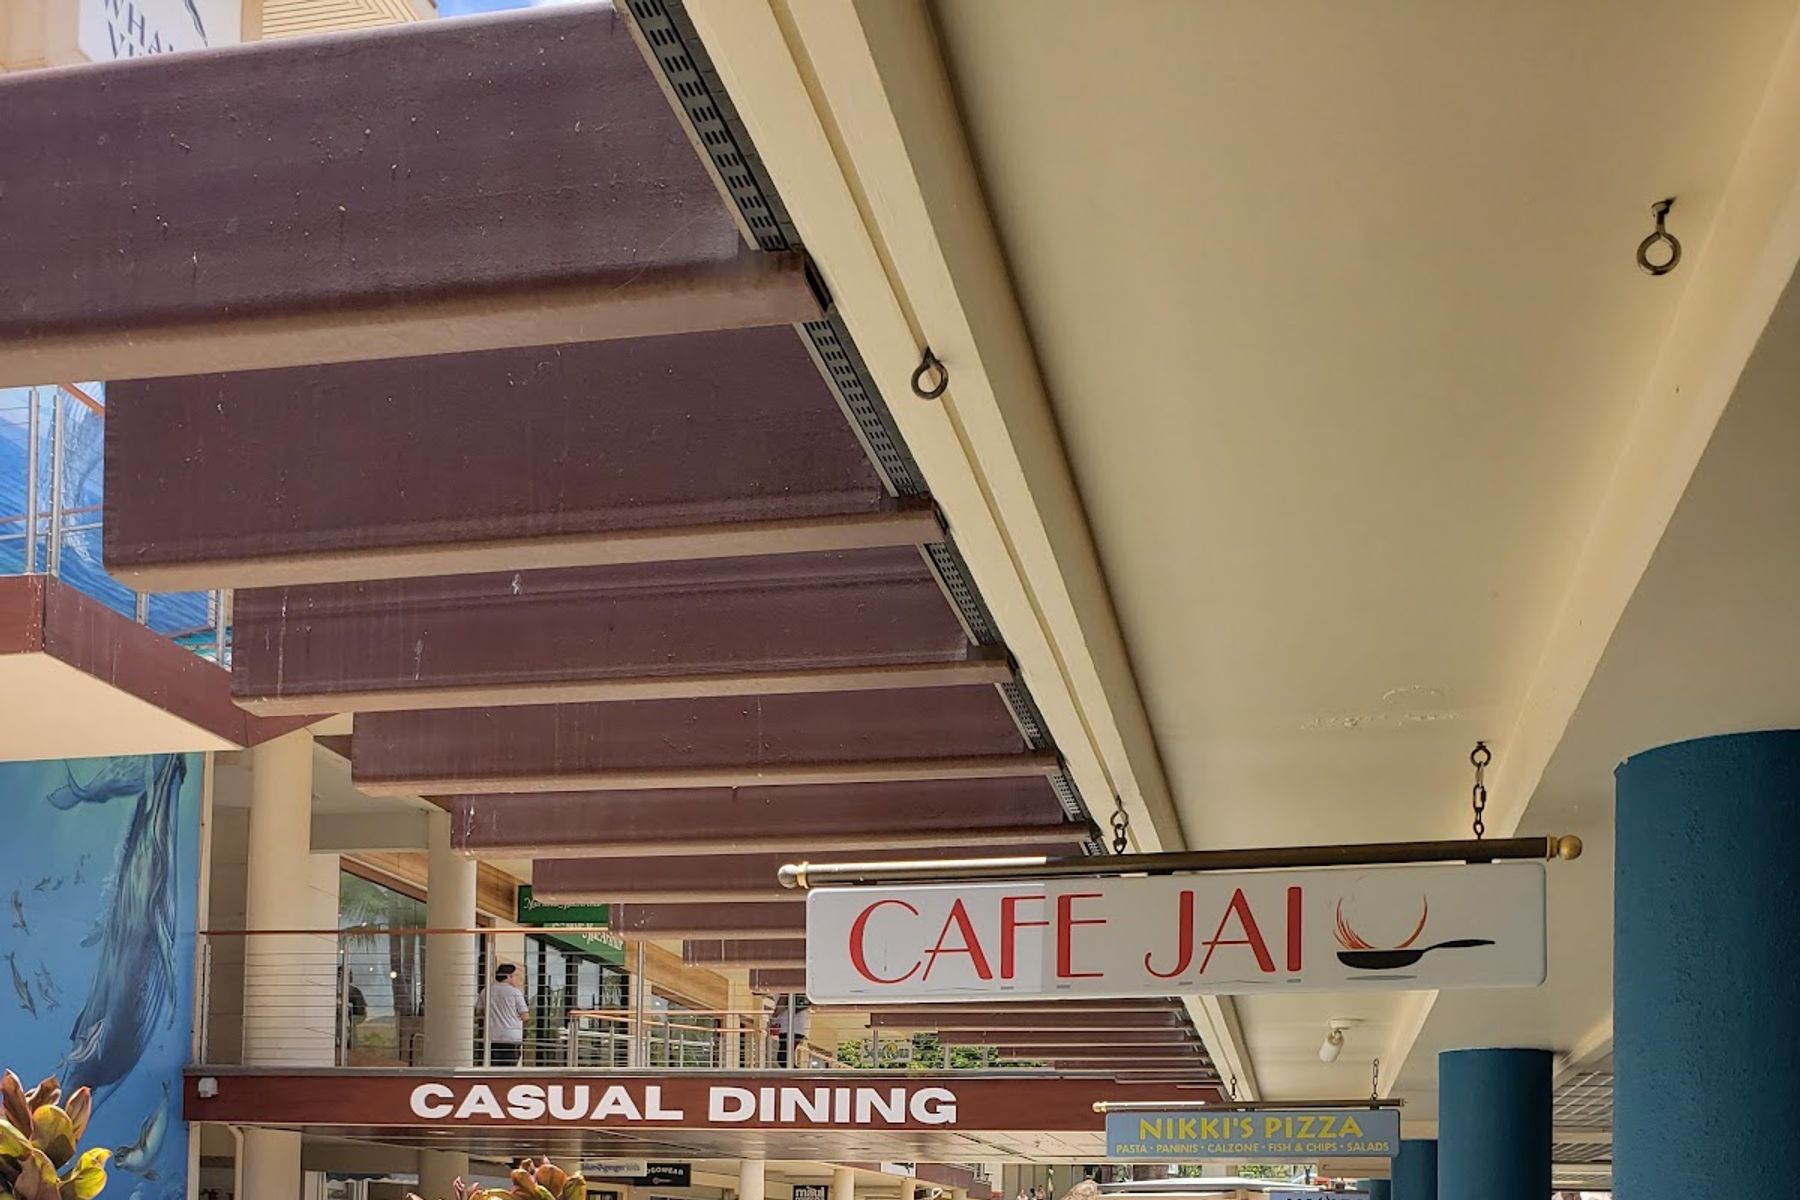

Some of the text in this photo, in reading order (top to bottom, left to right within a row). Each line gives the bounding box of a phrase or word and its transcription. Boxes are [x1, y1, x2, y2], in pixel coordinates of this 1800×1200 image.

[848, 885, 1302, 984] CAFE JAI
[409, 1083, 958, 1125] CASUAL DINING
[1139, 1115, 1364, 1141] NIKKI'S PIZZA
[1115, 1141, 1390, 1154] PASTA PANINIS CALZONE FISH & CHIPS SALADS
[646, 1166, 684, 1176] OGOWEAR
